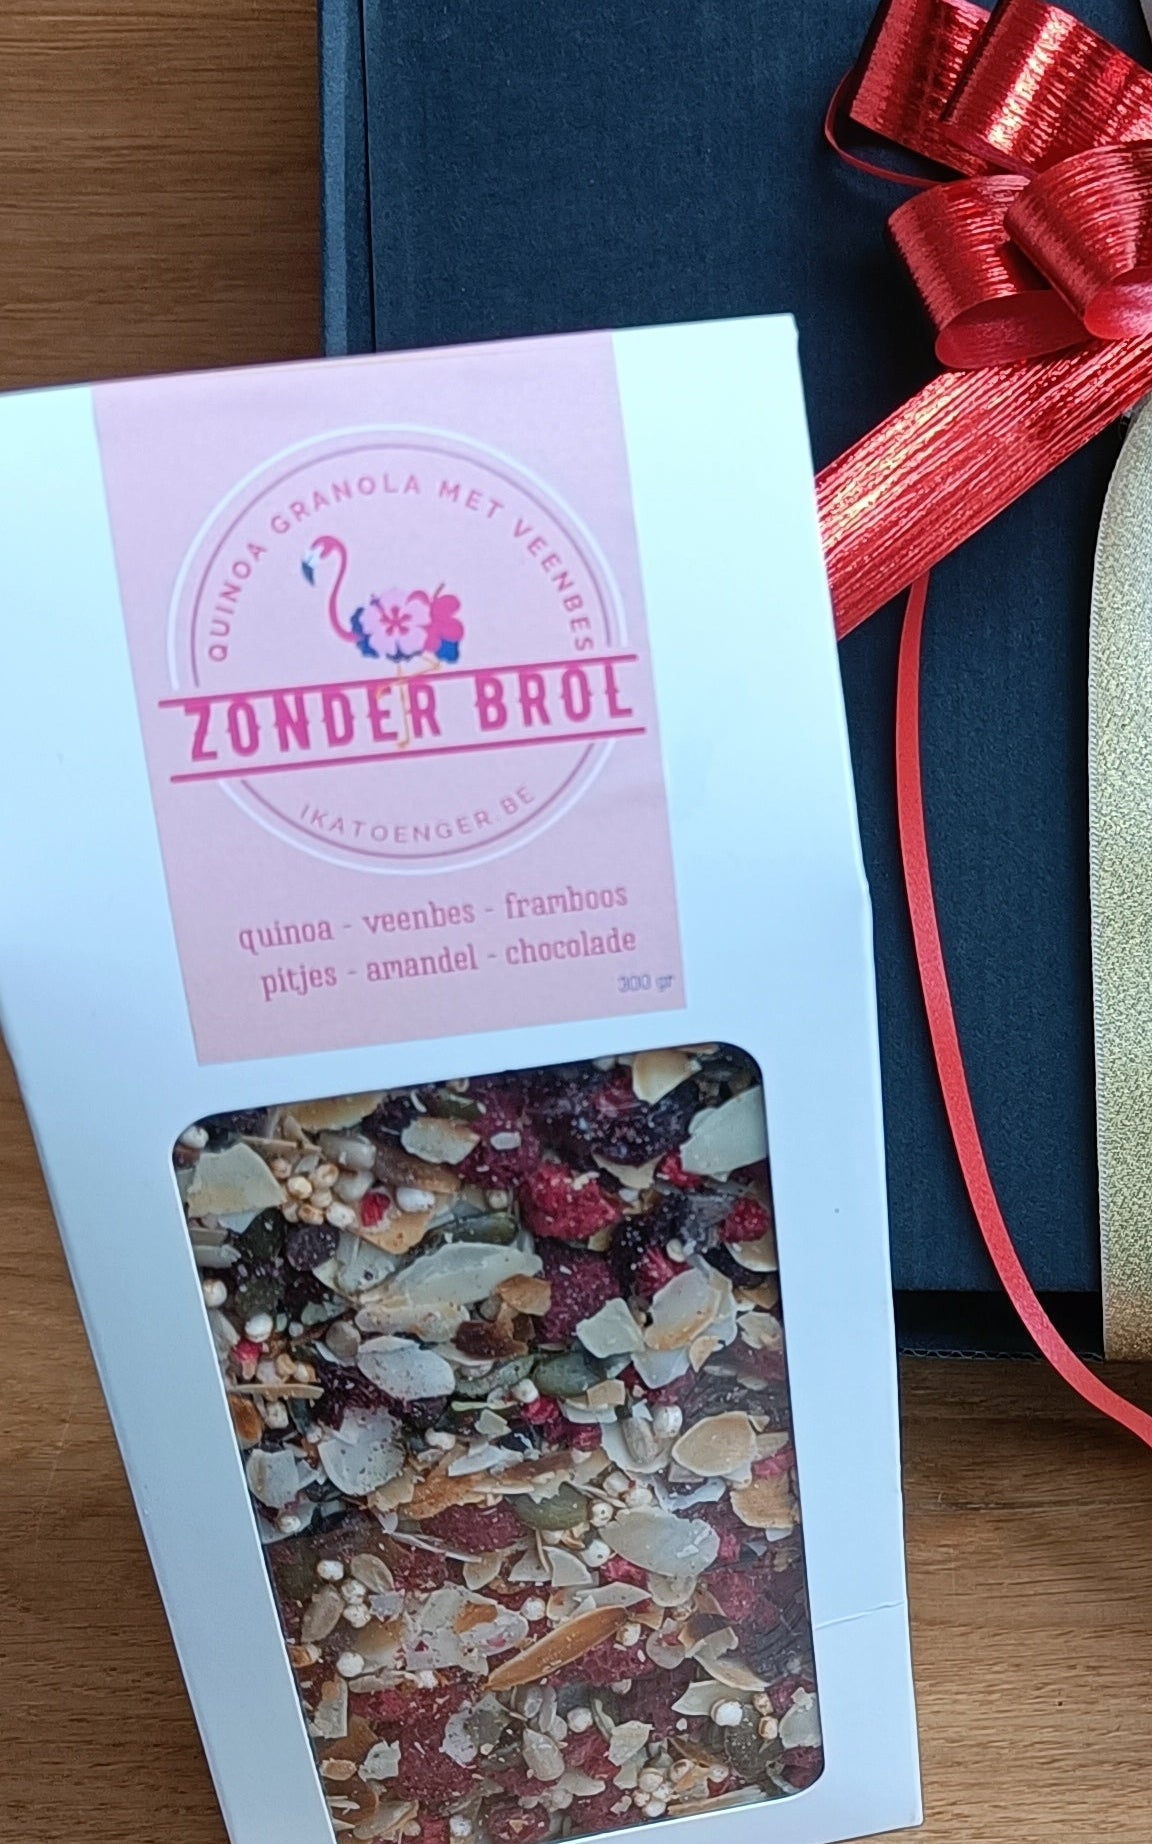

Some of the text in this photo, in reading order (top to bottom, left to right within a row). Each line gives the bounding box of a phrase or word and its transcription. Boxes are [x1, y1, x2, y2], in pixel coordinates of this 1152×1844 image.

[208, 473, 594, 662] QUINOA GRANOLA MET VEENBES
[184, 661, 633, 762] ZONDER BROL
[501, 785, 536, 815] BE
[238, 918, 335, 955] quinoa
[362, 902, 475, 935] veenbes
[505, 884, 629, 920] framboos
[260, 964, 337, 1001] pitjes
[366, 944, 479, 983] amandel
[505, 927, 637, 966] chocolade
